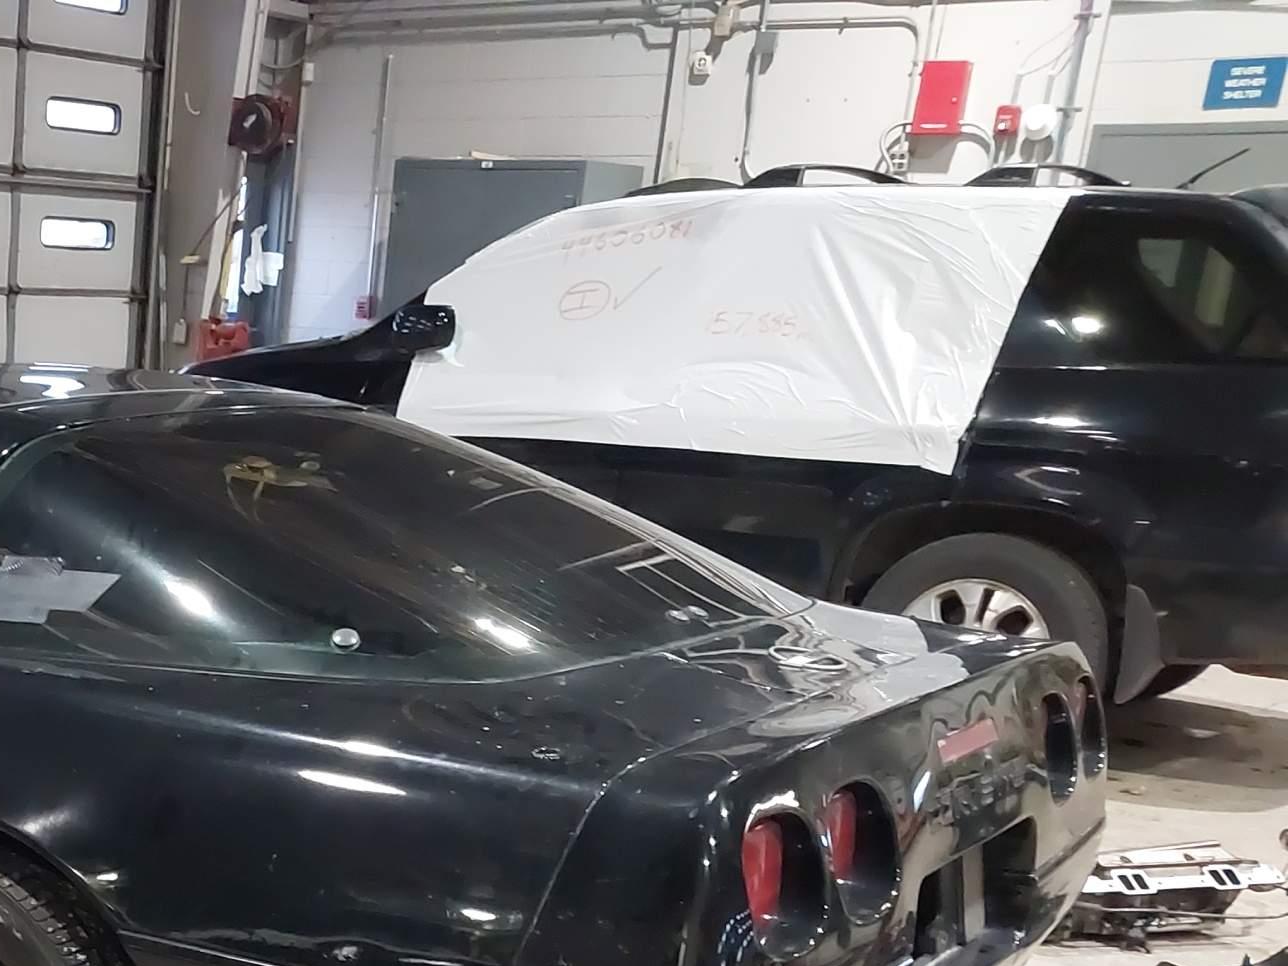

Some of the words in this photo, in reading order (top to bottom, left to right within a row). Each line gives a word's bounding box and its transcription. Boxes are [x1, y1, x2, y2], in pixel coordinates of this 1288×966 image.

[1230, 65, 1266, 76] SEVERE
[1223, 78, 1267, 88] WEATHER
[1222, 89, 1263, 100] SHELTER
